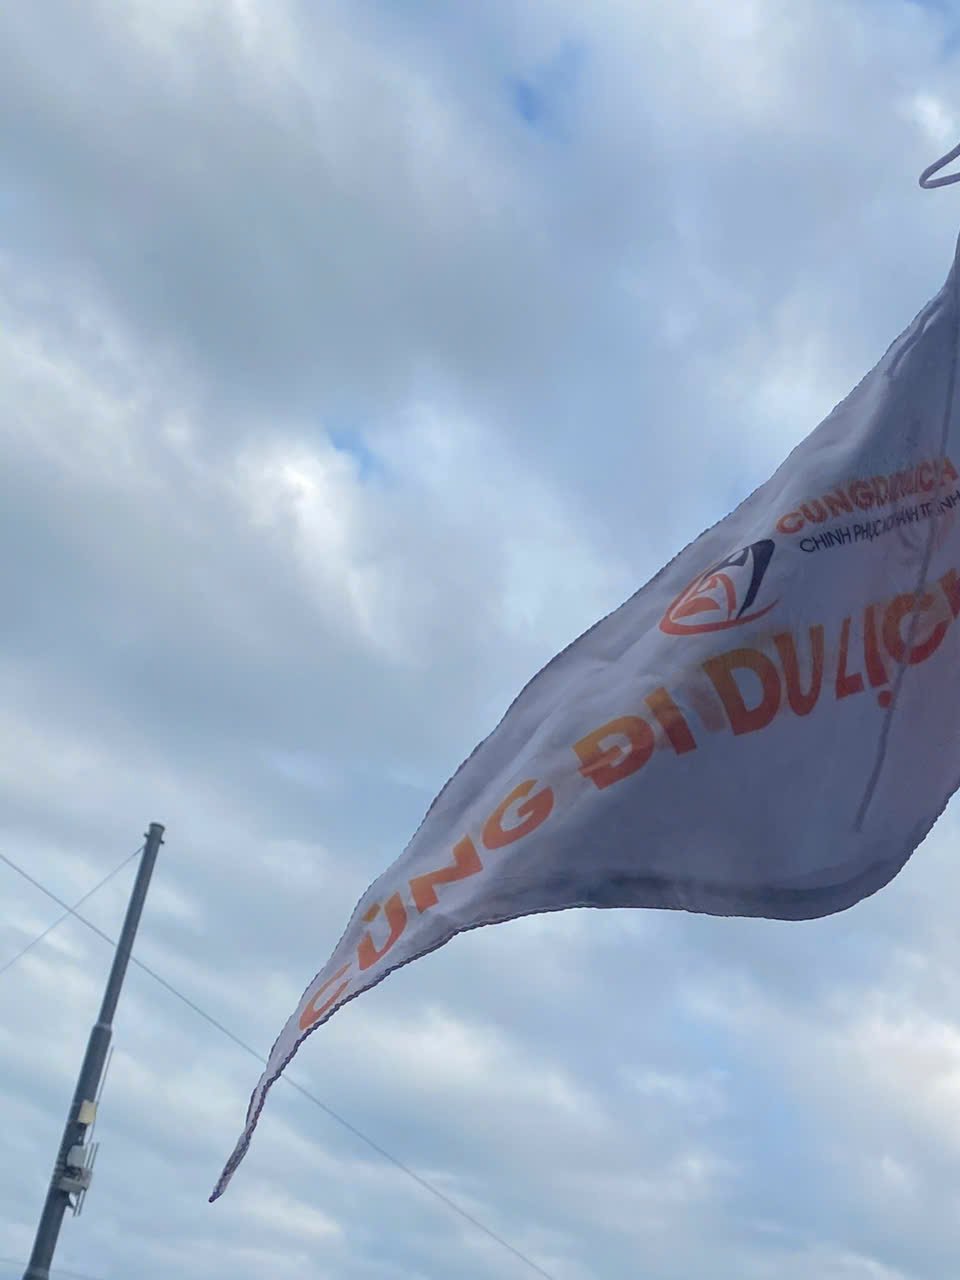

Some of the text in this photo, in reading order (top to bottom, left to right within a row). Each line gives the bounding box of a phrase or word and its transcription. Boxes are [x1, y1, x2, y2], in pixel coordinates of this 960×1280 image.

[299, 779, 555, 1031] CÙNG
[572, 687, 697, 791] ĐI
[703, 623, 825, 737] DU
